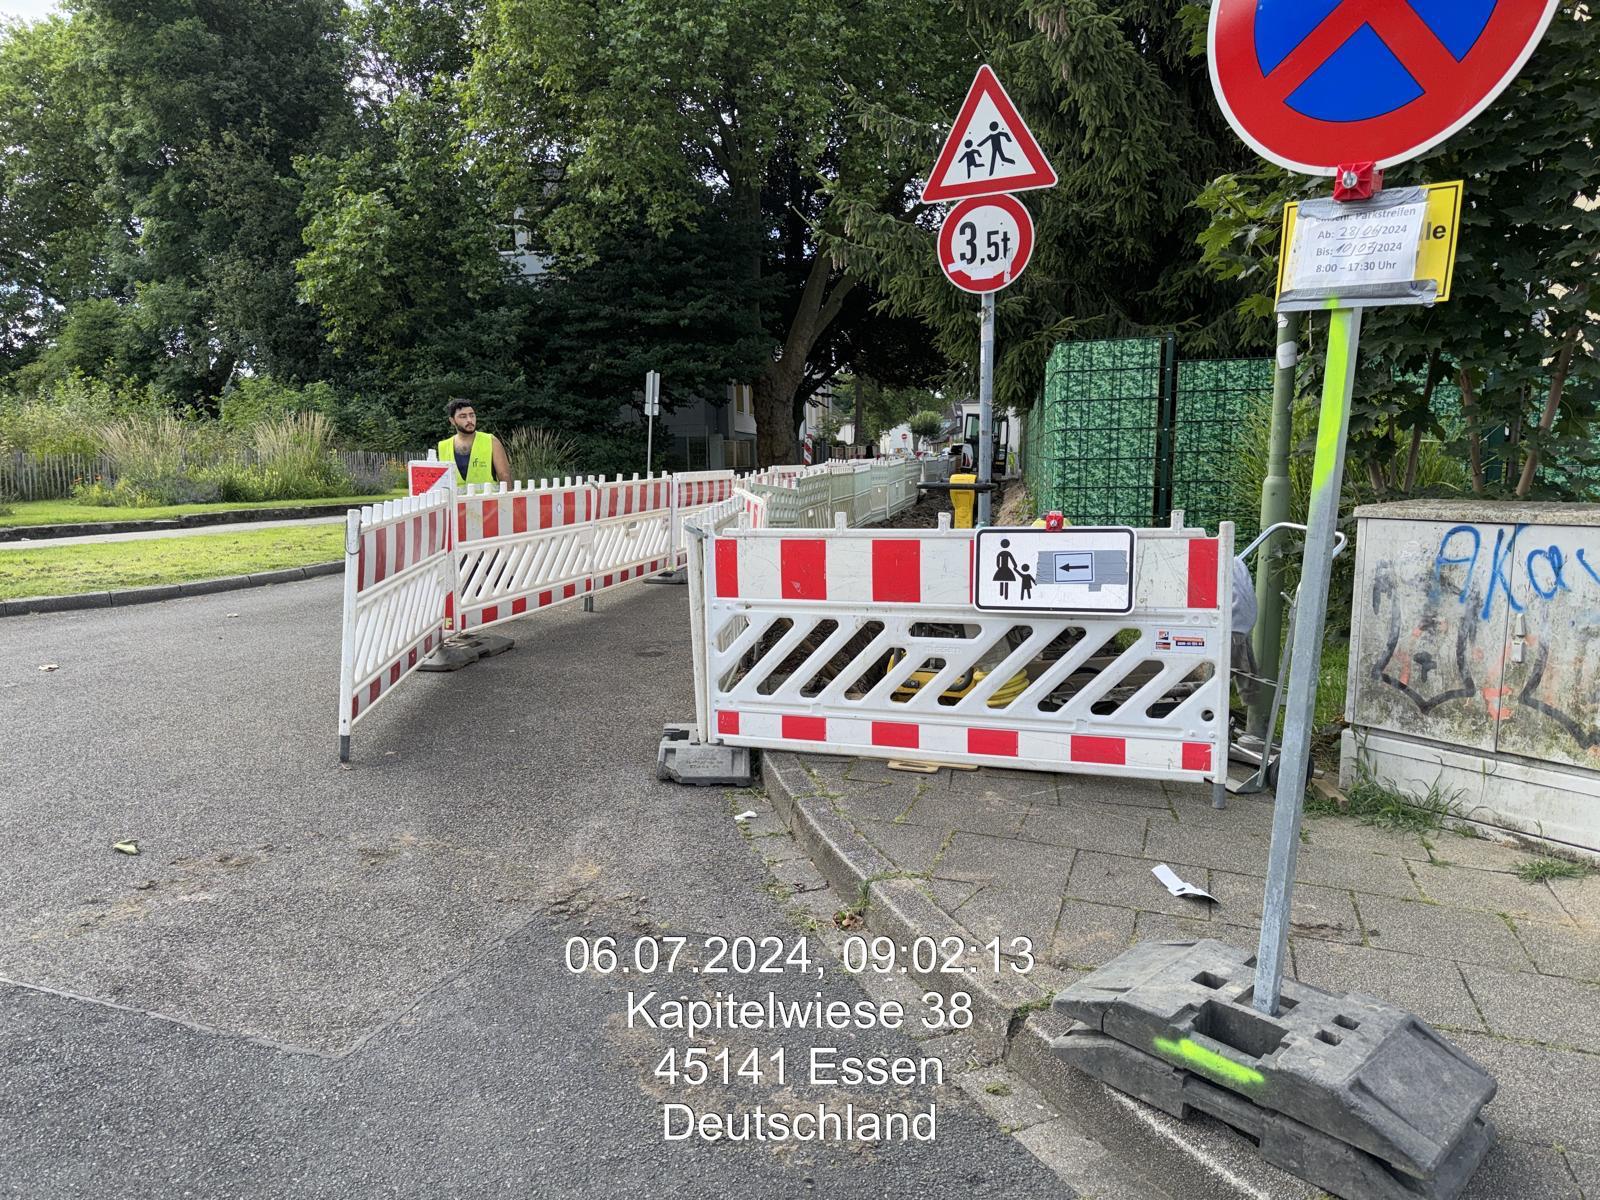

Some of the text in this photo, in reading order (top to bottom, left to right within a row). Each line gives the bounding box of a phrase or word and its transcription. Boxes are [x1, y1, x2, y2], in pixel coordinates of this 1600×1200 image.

[1318, 230, 1334, 239] Ab:
[960, 221, 1010, 265] 3,5t
[1316, 248, 1333, 257] Bis:
[1316, 264, 1337, 273] 8:00
[1348, 262, 1375, 272] 17:30
[1378, 260, 1397, 270] Uhr
